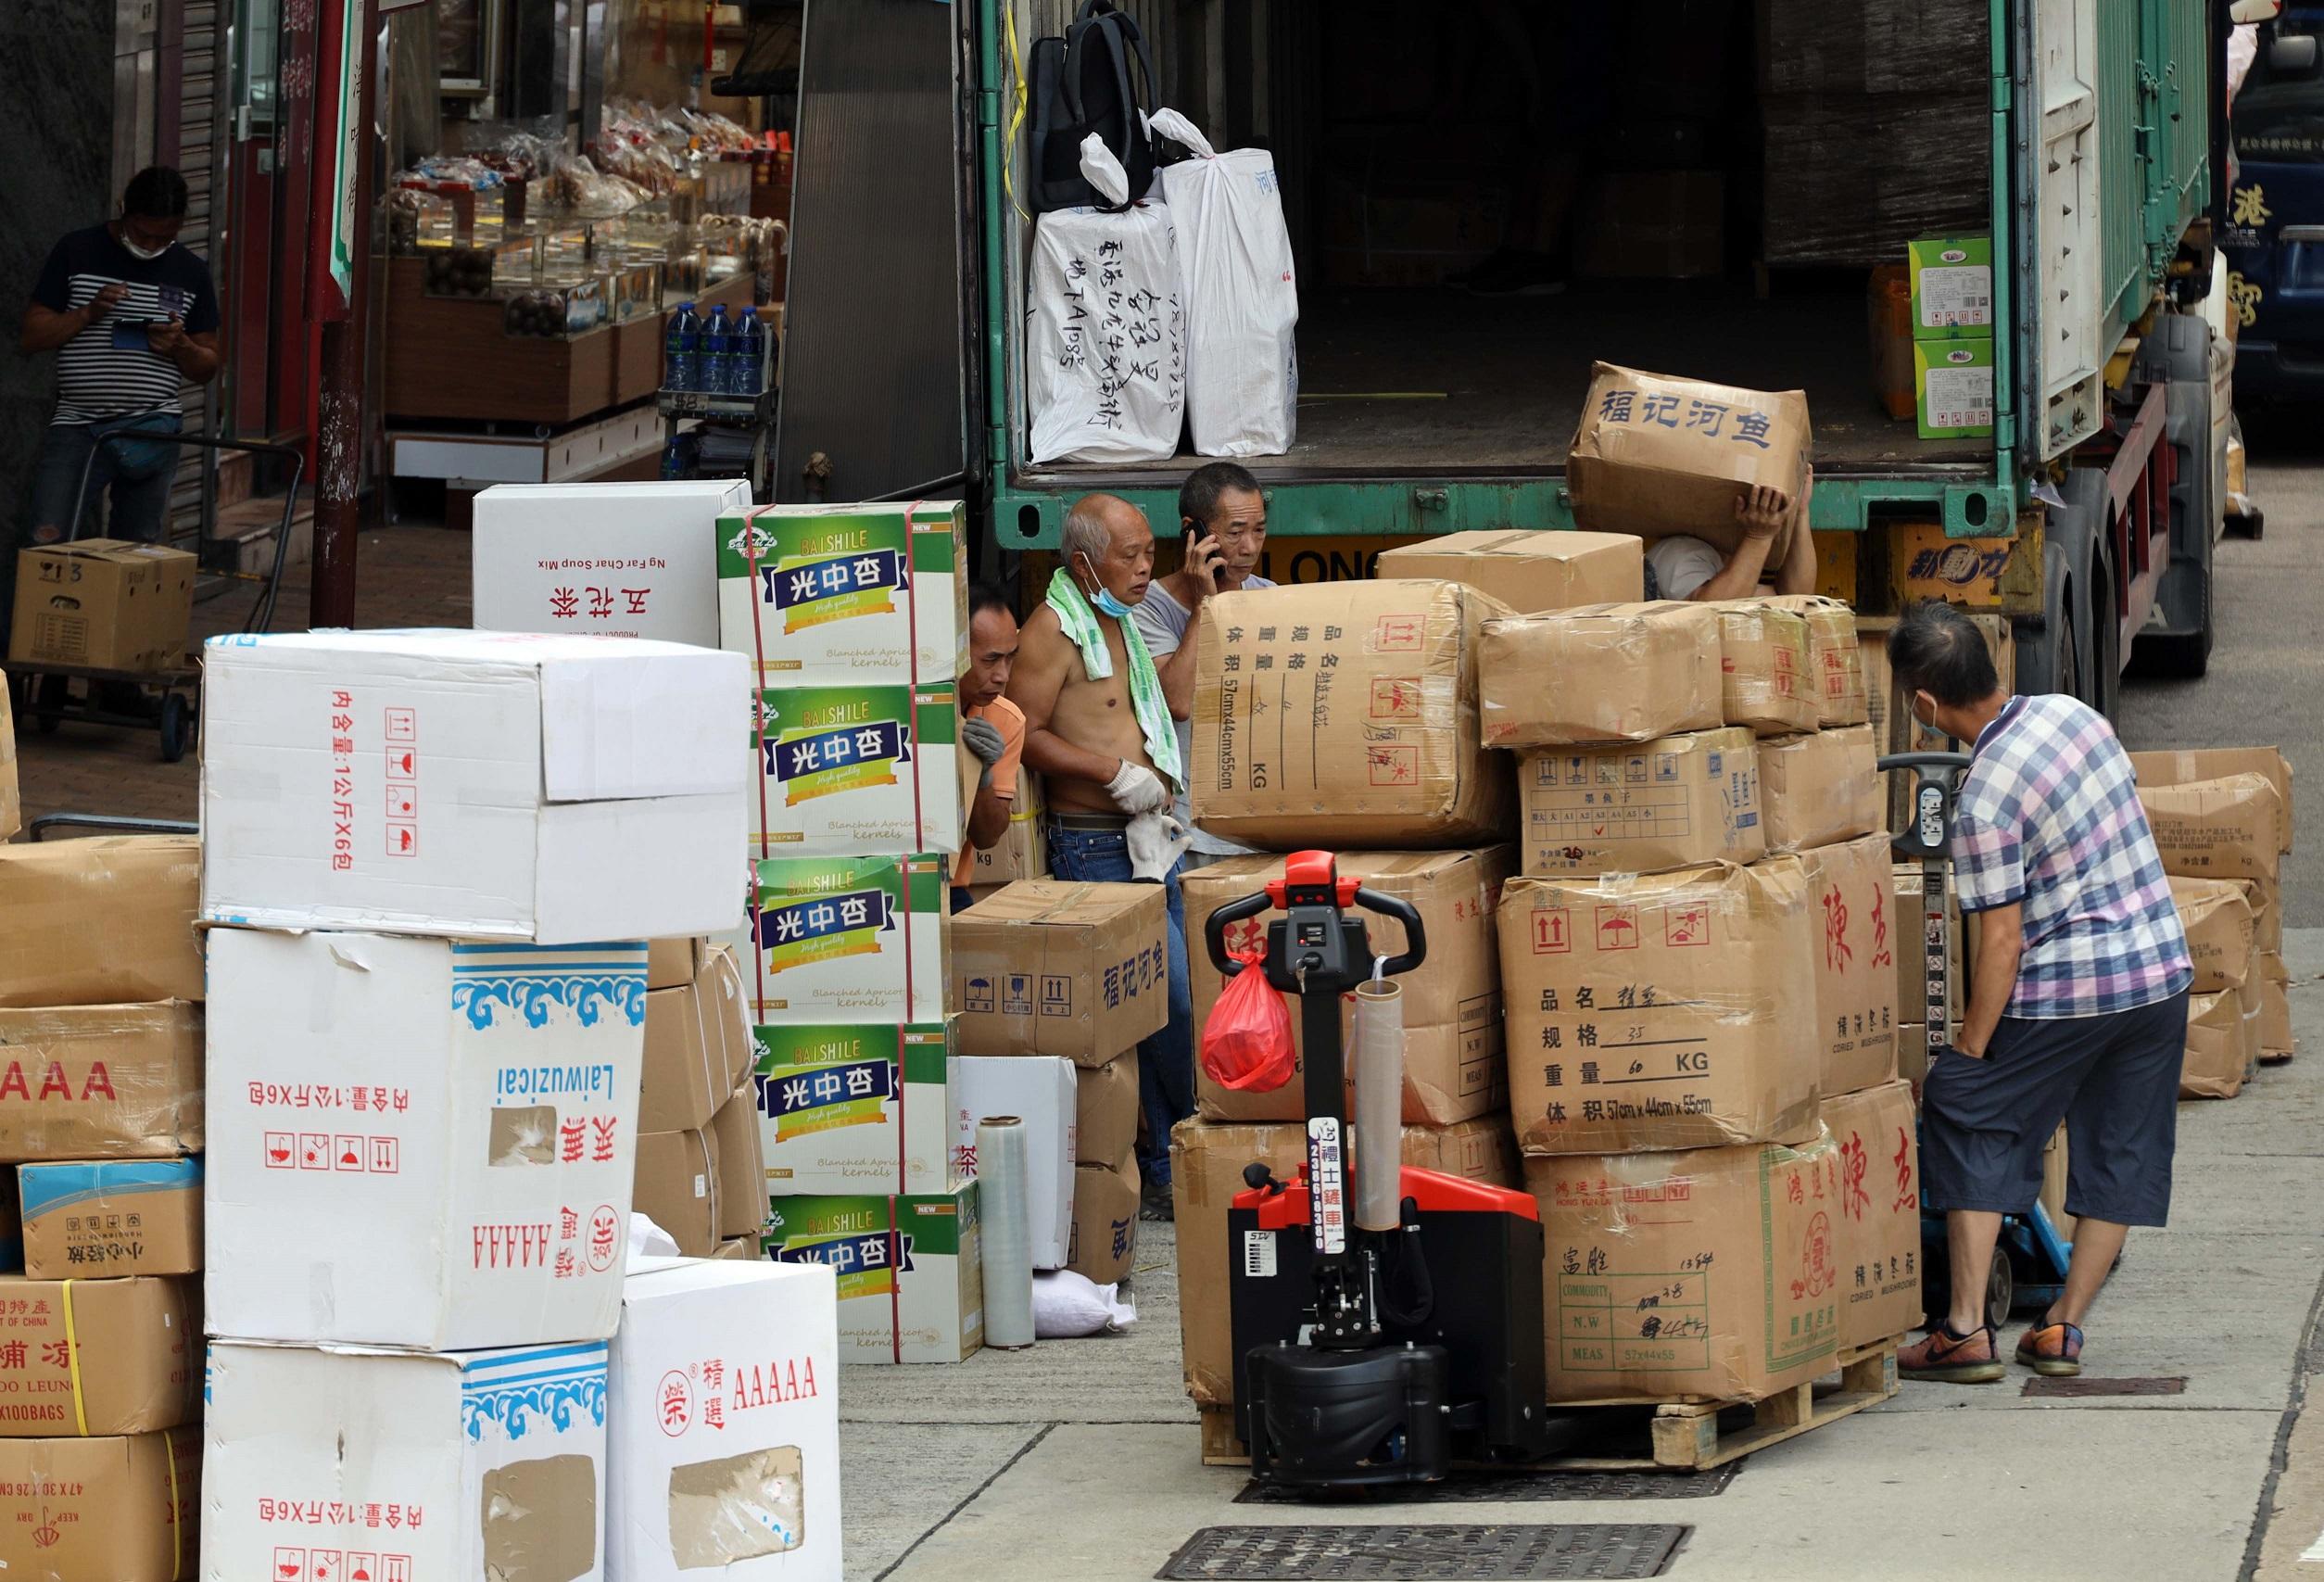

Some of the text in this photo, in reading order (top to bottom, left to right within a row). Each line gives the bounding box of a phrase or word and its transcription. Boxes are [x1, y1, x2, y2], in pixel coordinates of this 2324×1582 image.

[1599, 390, 1771, 449] 福记河鱼
[912, 524, 931, 532] NEW
[801, 529, 868, 556] BAISHILE
[537, 558, 665, 570] Ng Far Char Soup Mix
[789, 557, 881, 602] 光中杏
[549, 587, 651, 618] 五花茶
[833, 594, 859, 609] quality
[826, 648, 877, 658] Blanched
[1255, 626, 1277, 672] 重量
[1287, 625, 1310, 671] 规格
[1320, 625, 1342, 669] 品名
[851, 657, 903, 668] kernels
[802, 702, 869, 728] BAISHILE
[791, 728, 883, 774] 光中杏
[835, 766, 861, 781] quality
[1252, 762, 1267, 790] KG
[853, 829, 903, 840] kernels
[977, 851, 992, 867] kg
[788, 871, 853, 896] BAISHILE
[777, 897, 868, 942] 光中杏
[1103, 939, 1165, 1011] 福记河鱼
[2212, 969, 2225, 980] kg
[837, 997, 888, 1008] kernels
[1540, 986, 1594, 1012] 品名
[905, 1034, 924, 1043] NEW
[1541, 1023, 1598, 1049] 规格
[794, 1039, 861, 1066] BAISHILE
[1676, 1052, 1709, 1072] KG
[1544, 1059, 1602, 1088] 重量
[497, 1064, 614, 1105] Laiwuzicai
[783, 1067, 873, 1111] 光中杏
[817, 1158, 867, 1167] Blanched
[841, 1167, 892, 1178] kernels
[917, 1206, 936, 1214] NEW
[807, 1210, 874, 1235] BAISHILE
[474, 1223, 552, 1269] AAAAA
[8, 1316, 19, 1327] OF
[22, 1316, 47, 1327] CHINA
[839, 1328, 881, 1337] lanched
[1572, 1349, 1604, 1361] MEAS
[732, 1356, 818, 1411] AAAAA
[16, 1482, 29, 1496] 26
[43, 1482, 57, 1496] 30
[59, 1483, 68, 1496] X
[69, 1482, 83, 1497] 47
[16, 1511, 80, 1523] KEEP DRY
